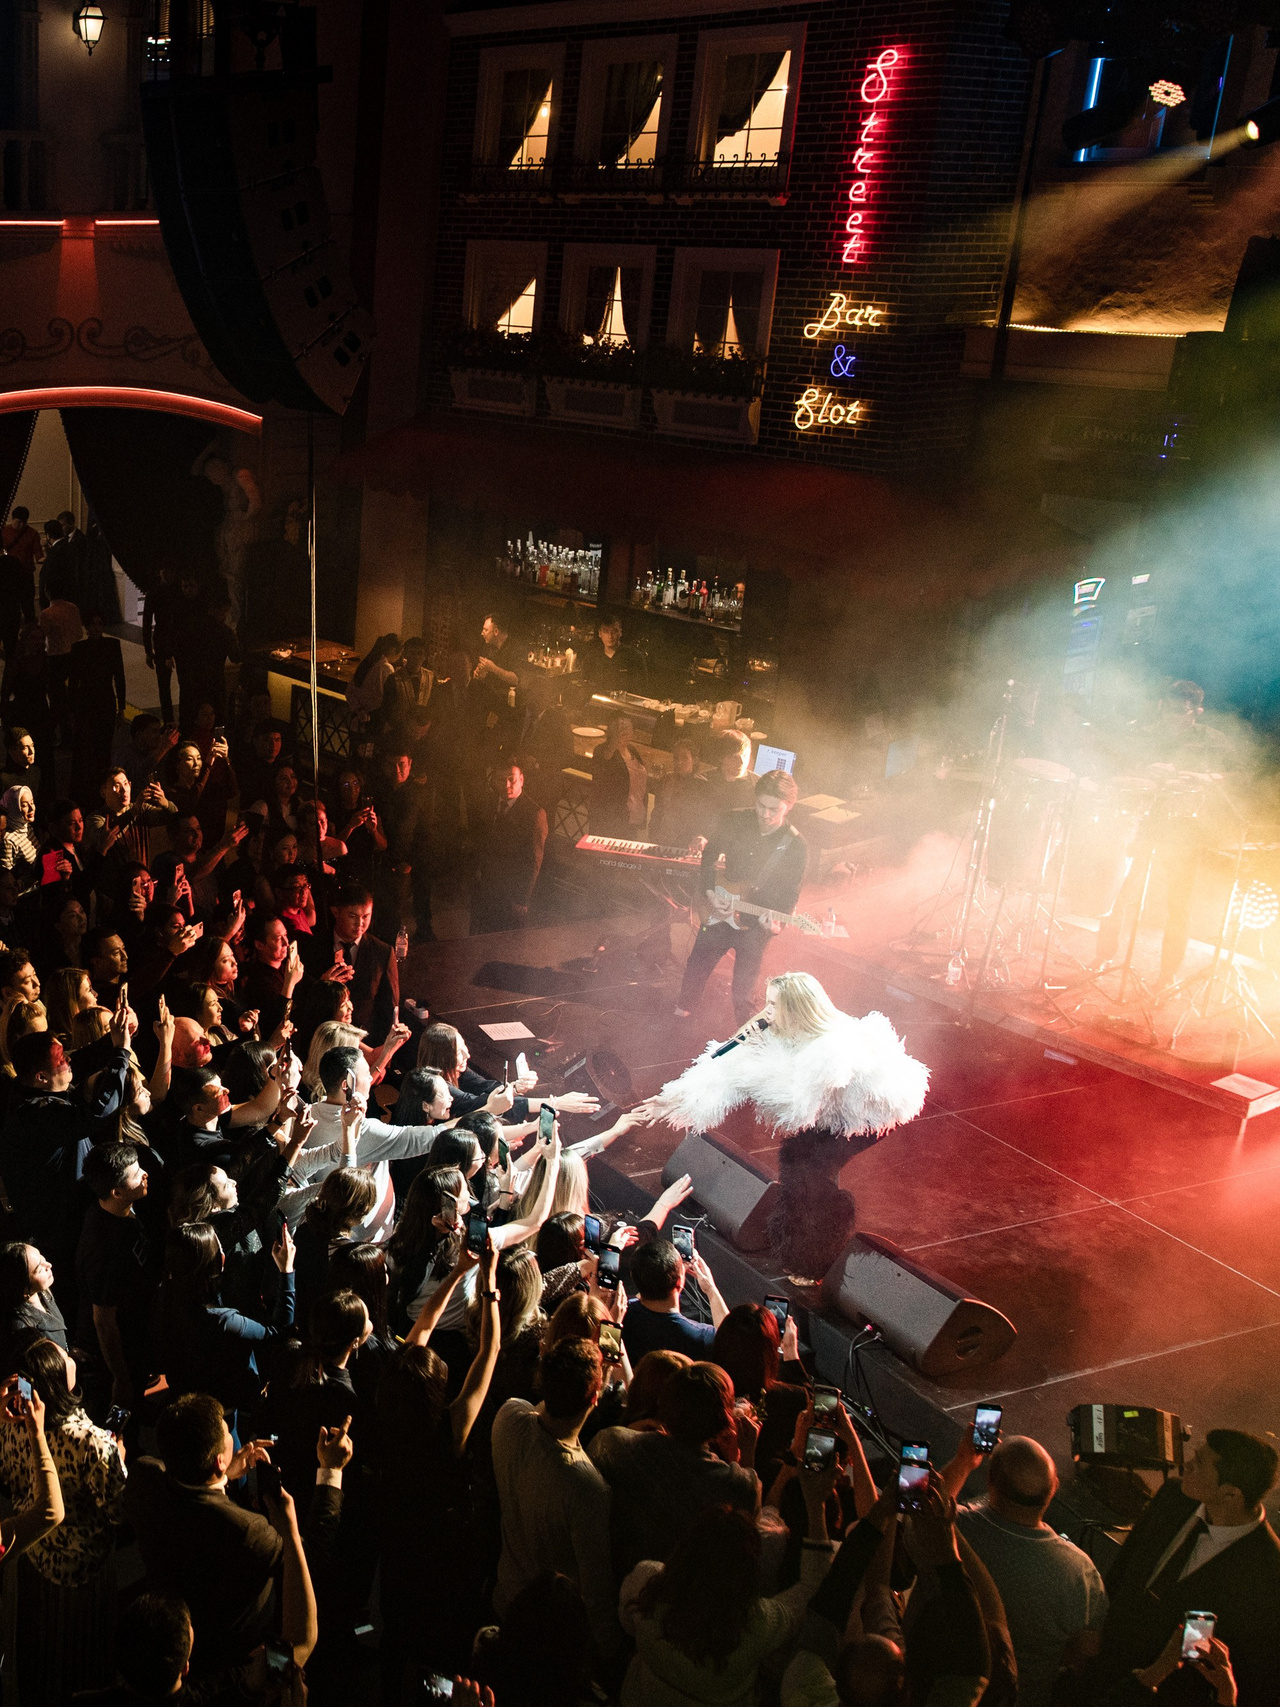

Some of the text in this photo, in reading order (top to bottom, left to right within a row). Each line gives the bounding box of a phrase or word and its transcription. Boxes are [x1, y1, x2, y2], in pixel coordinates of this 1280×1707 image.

[842, 48, 899, 263] Street
[803, 292, 882, 339] Bar
[830, 344, 857, 378] &
[794, 388, 862, 430] Slot
